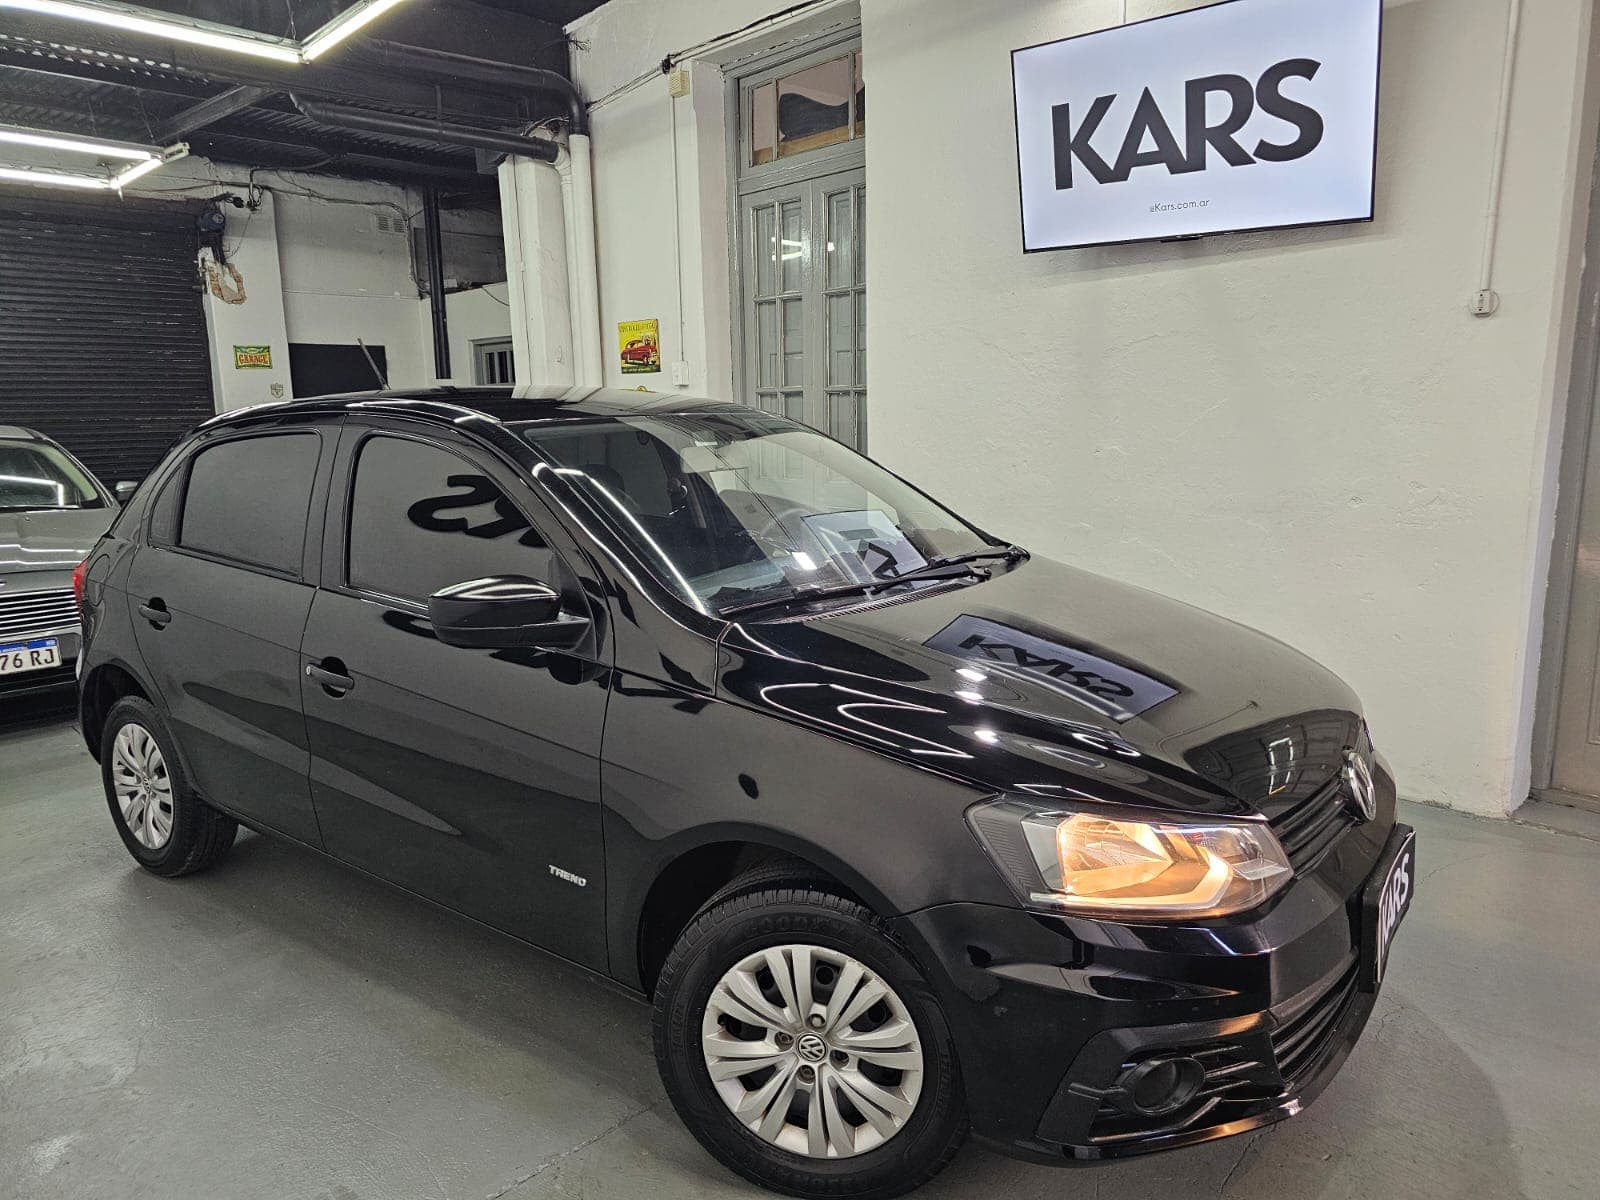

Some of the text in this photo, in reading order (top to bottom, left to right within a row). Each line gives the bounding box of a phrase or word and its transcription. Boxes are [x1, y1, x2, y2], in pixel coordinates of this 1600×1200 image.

[1051, 58, 1324, 190] KARS
[30, 648, 55, 666] RJ
[548, 864, 587, 887] TREND
[1381, 852, 1410, 959] KARS
